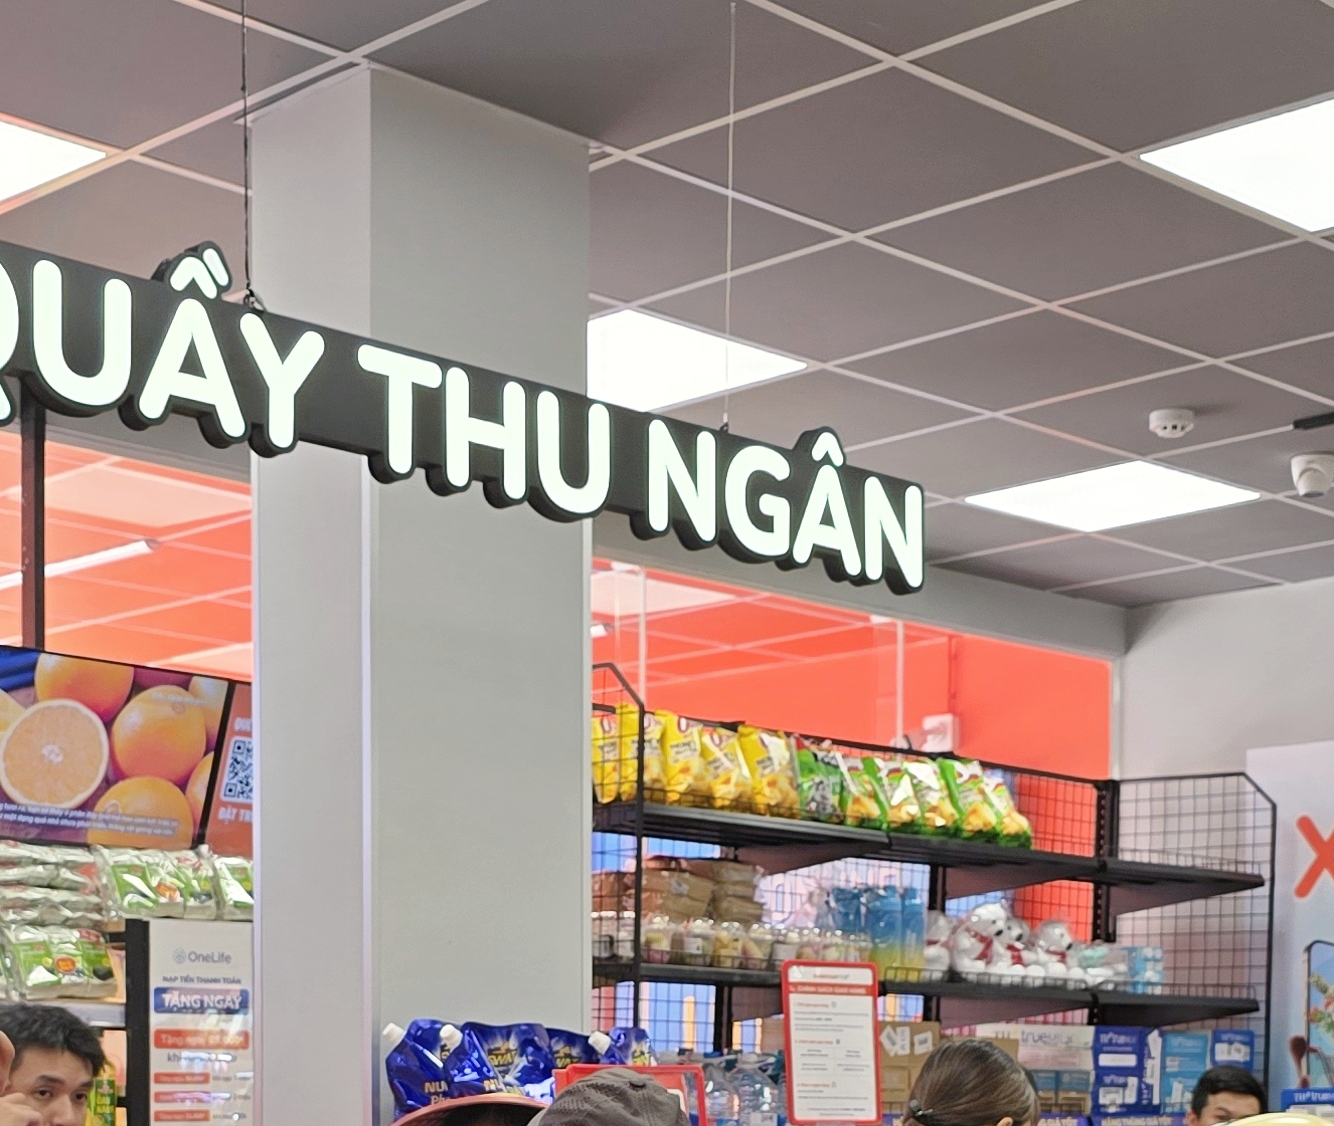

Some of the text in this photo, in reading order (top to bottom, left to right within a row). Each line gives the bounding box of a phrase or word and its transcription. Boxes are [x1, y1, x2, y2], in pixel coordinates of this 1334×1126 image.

[357, 343, 612, 516] THU
[647, 426, 925, 592] NGÂN
[188, 950, 232, 964] OneLife
[162, 990, 242, 1012] TẶNG NGAY
